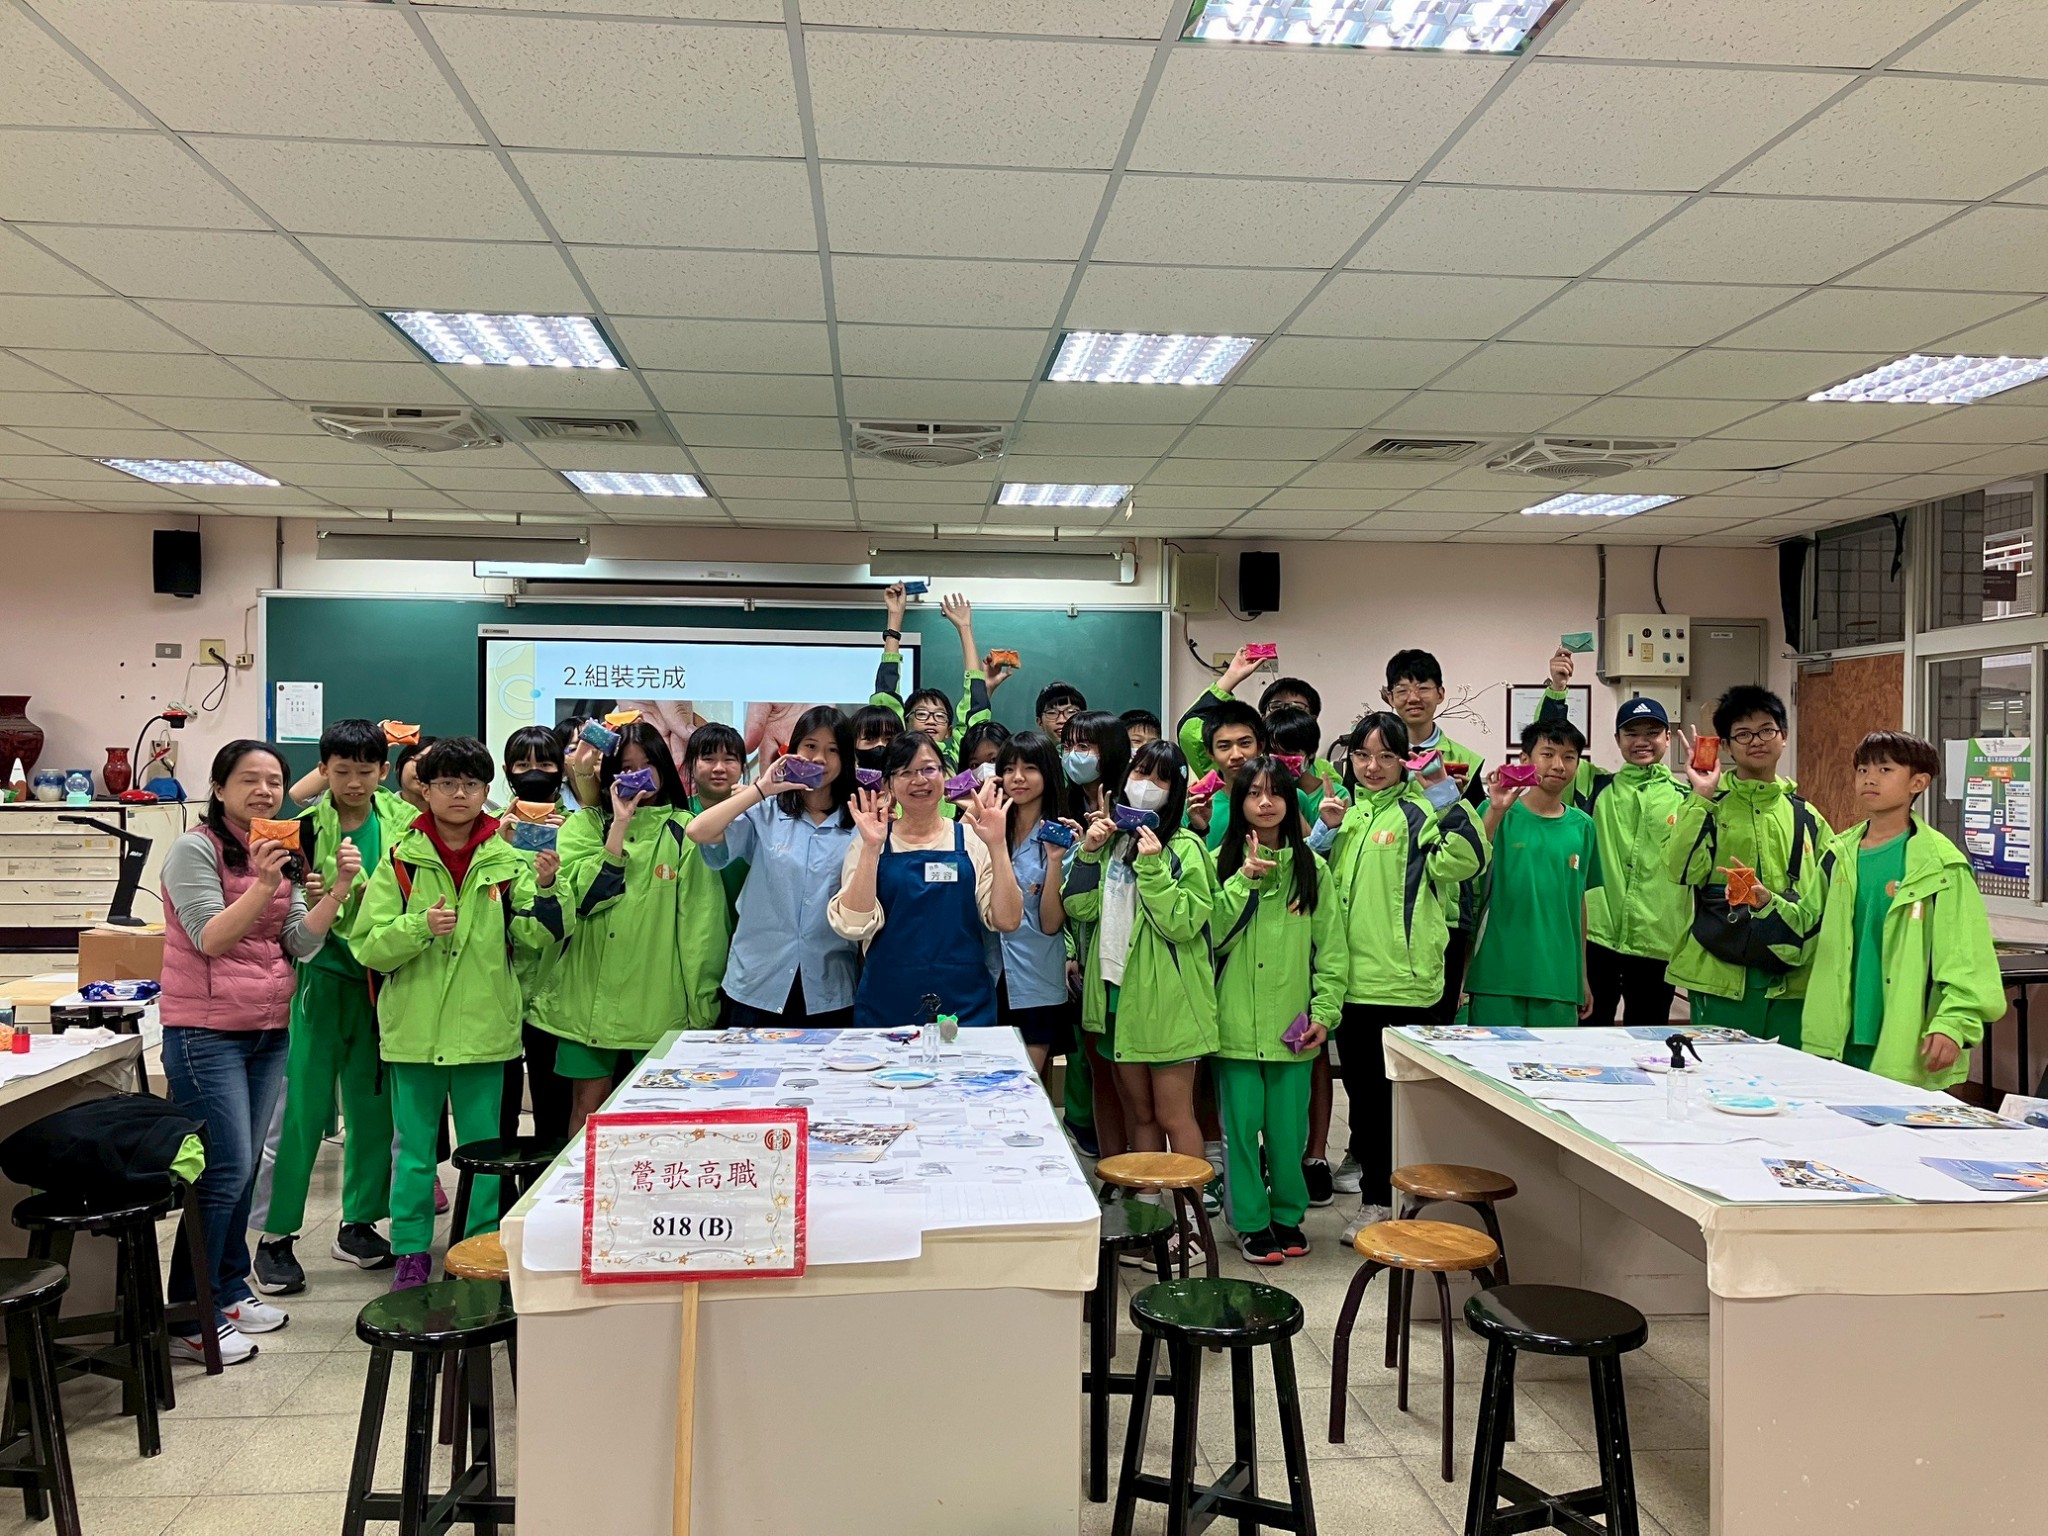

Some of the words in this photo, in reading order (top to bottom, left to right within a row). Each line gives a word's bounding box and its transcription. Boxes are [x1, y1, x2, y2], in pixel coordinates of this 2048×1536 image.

[563, 664, 686, 689] 2.組裝完成
[631, 1158, 758, 1192] 鶯歌高職
